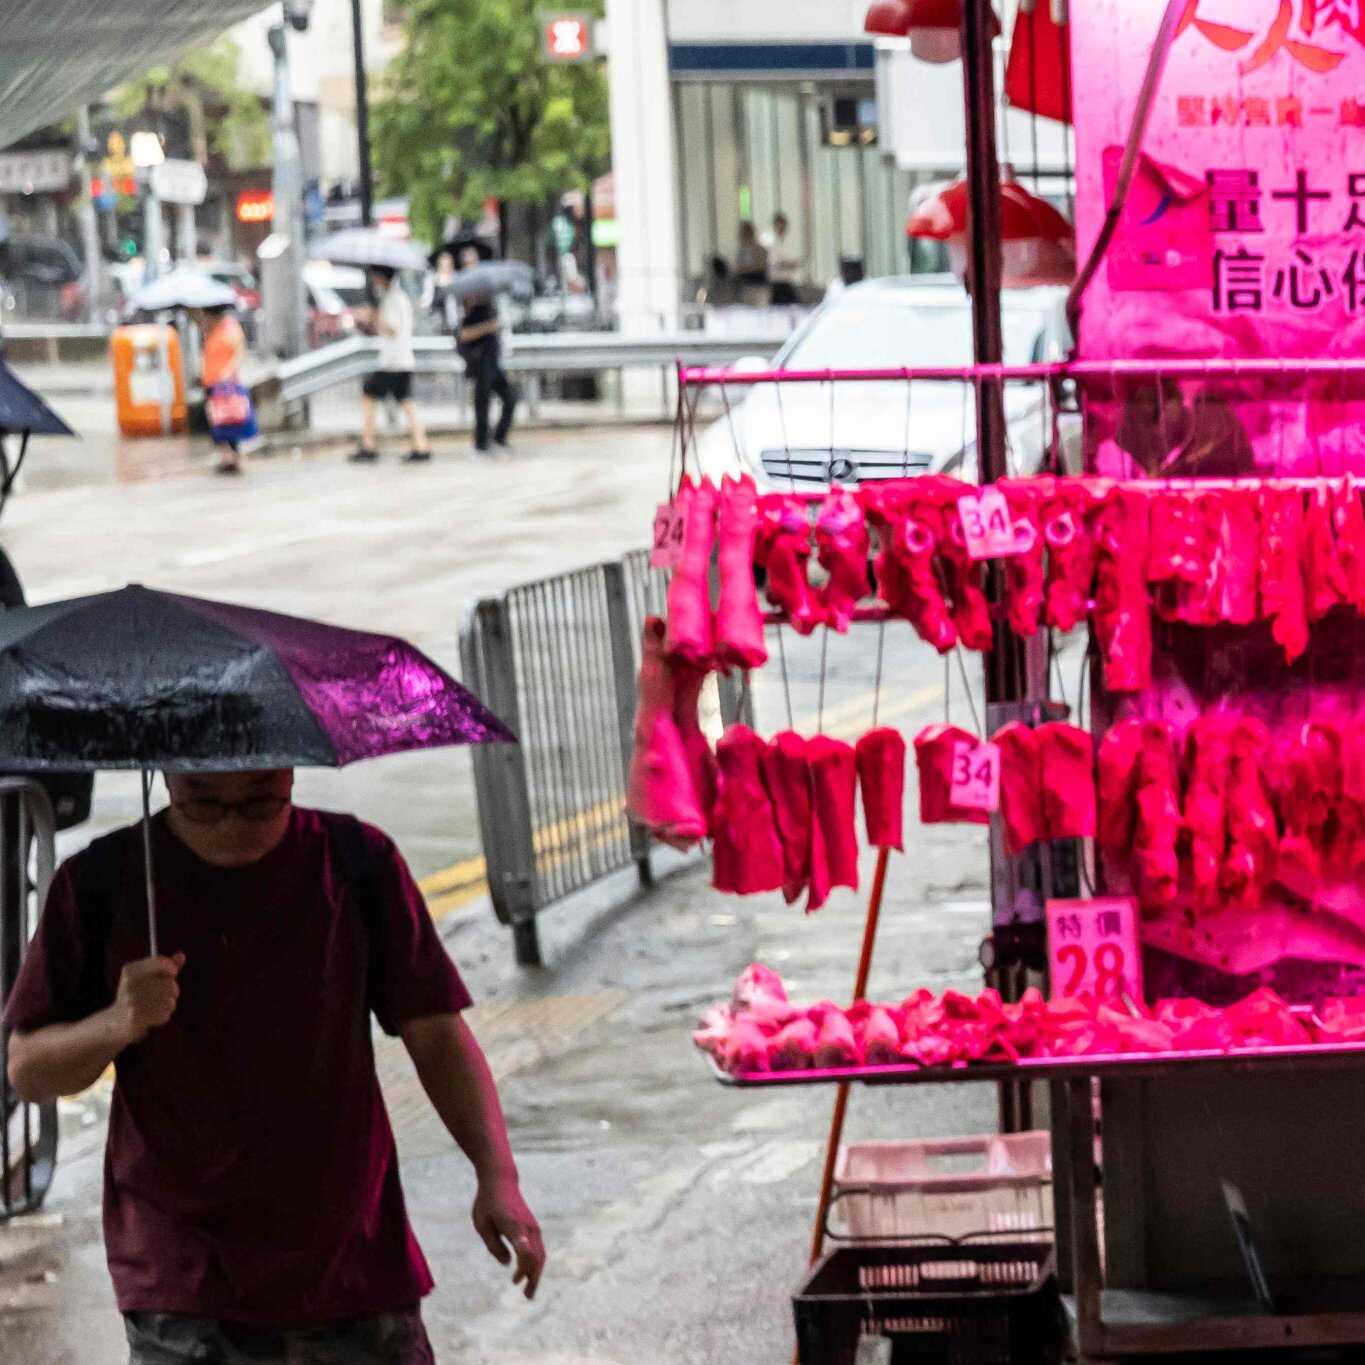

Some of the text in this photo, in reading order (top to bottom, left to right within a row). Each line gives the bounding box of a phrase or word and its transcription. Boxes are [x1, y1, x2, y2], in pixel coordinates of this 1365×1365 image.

[654, 517, 684, 550] 24
[965, 508, 1006, 539] 34
[954, 754, 993, 788] 34
[1057, 942, 1125, 998] 28
